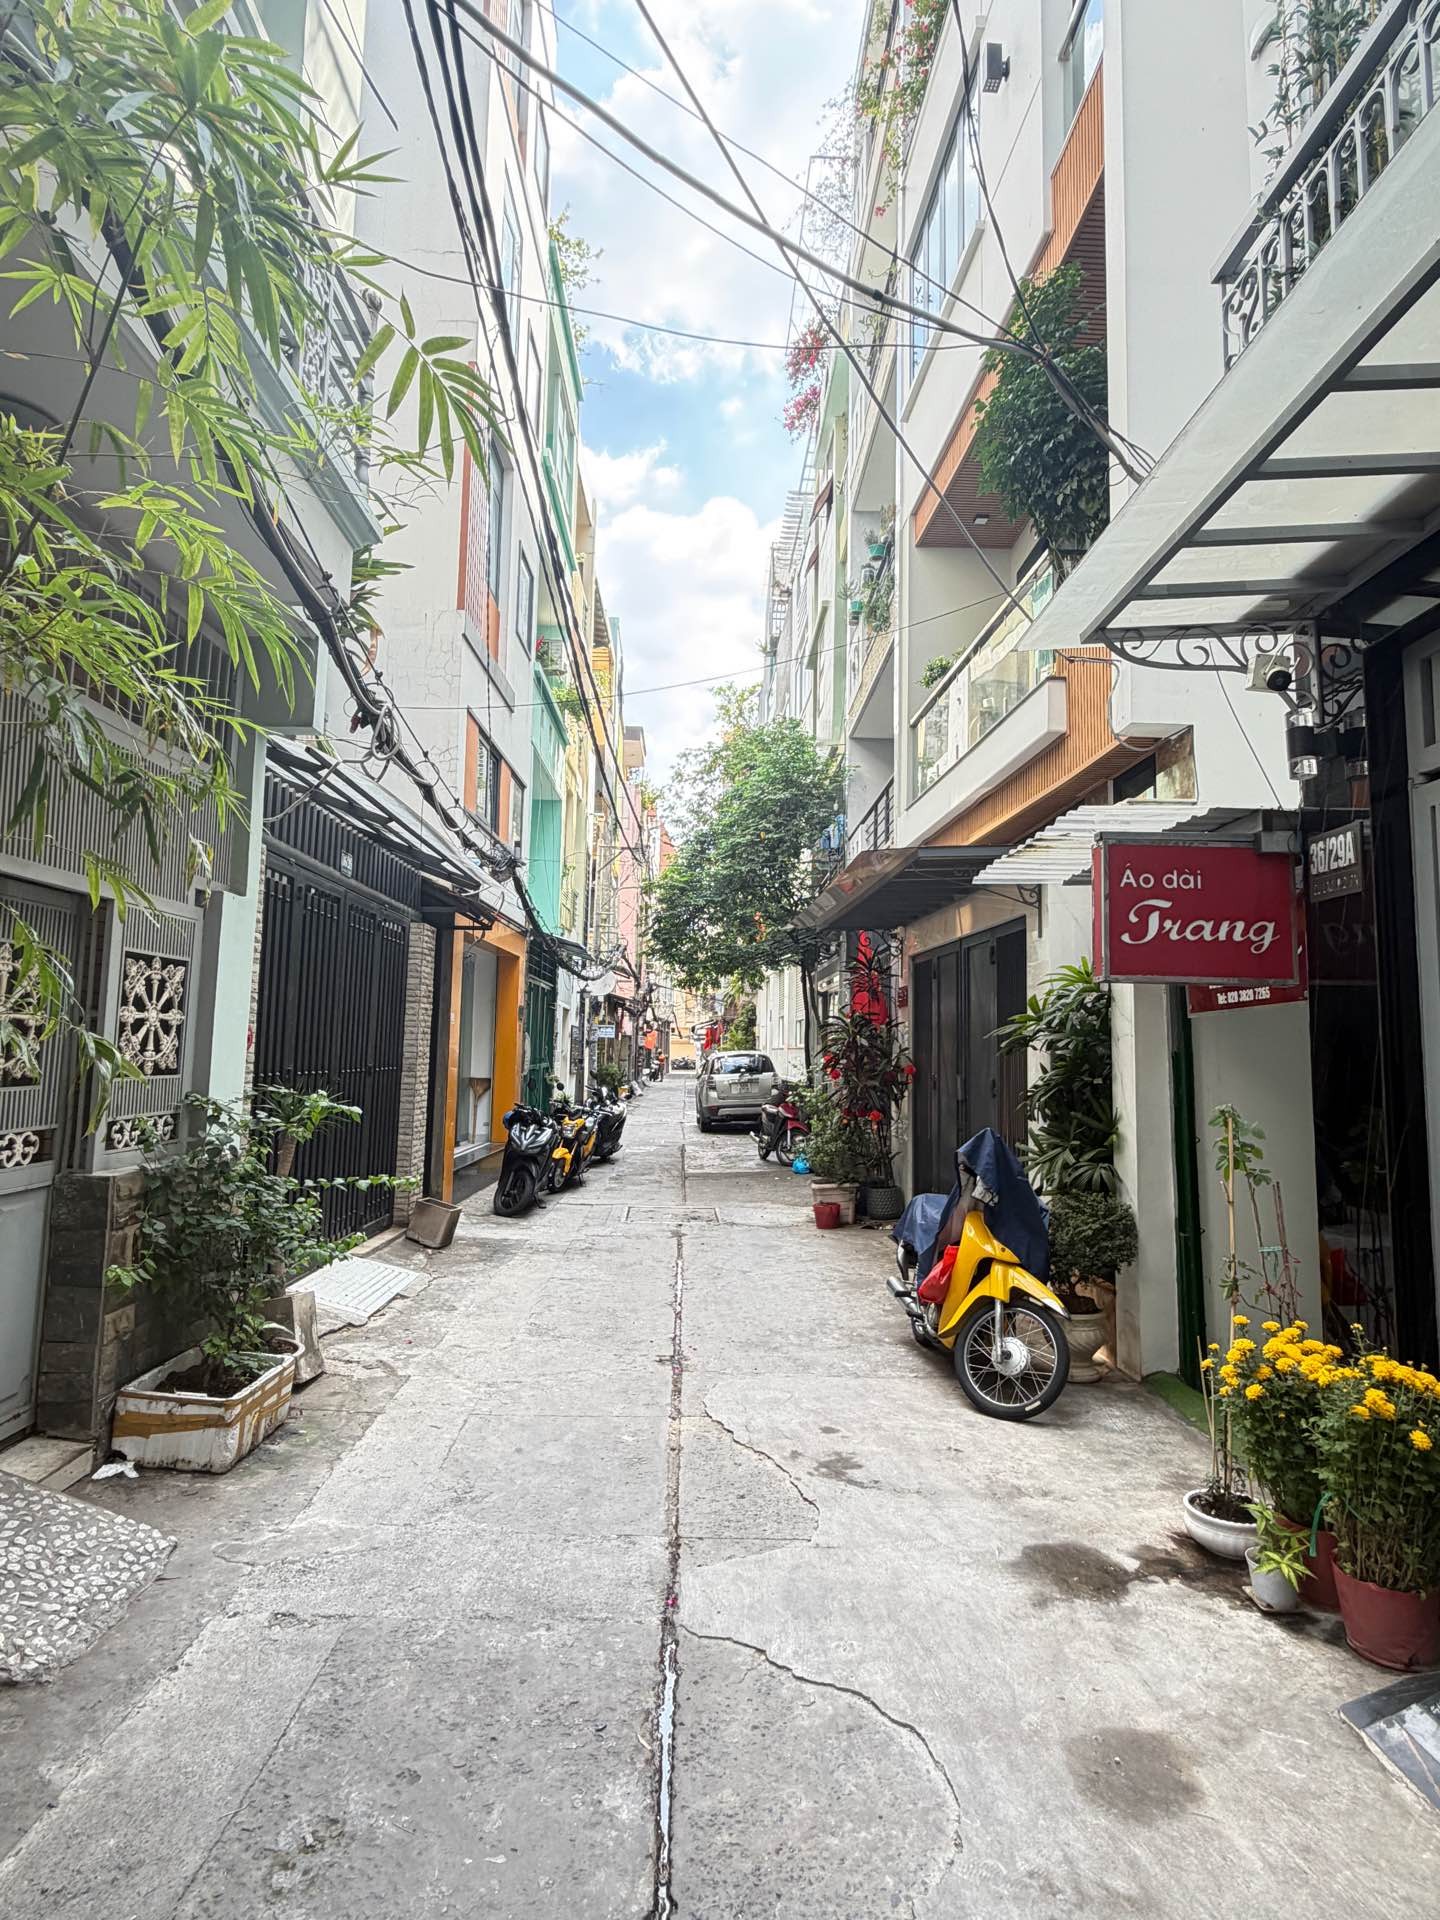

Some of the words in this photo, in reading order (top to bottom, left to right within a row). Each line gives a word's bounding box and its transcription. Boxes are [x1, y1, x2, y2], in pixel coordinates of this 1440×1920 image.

[1310, 831, 1355, 875] 36/29A
[1120, 863, 1155, 888] Áo
[1162, 869, 1202, 890] dài
[1120, 899, 1281, 954] Trang
